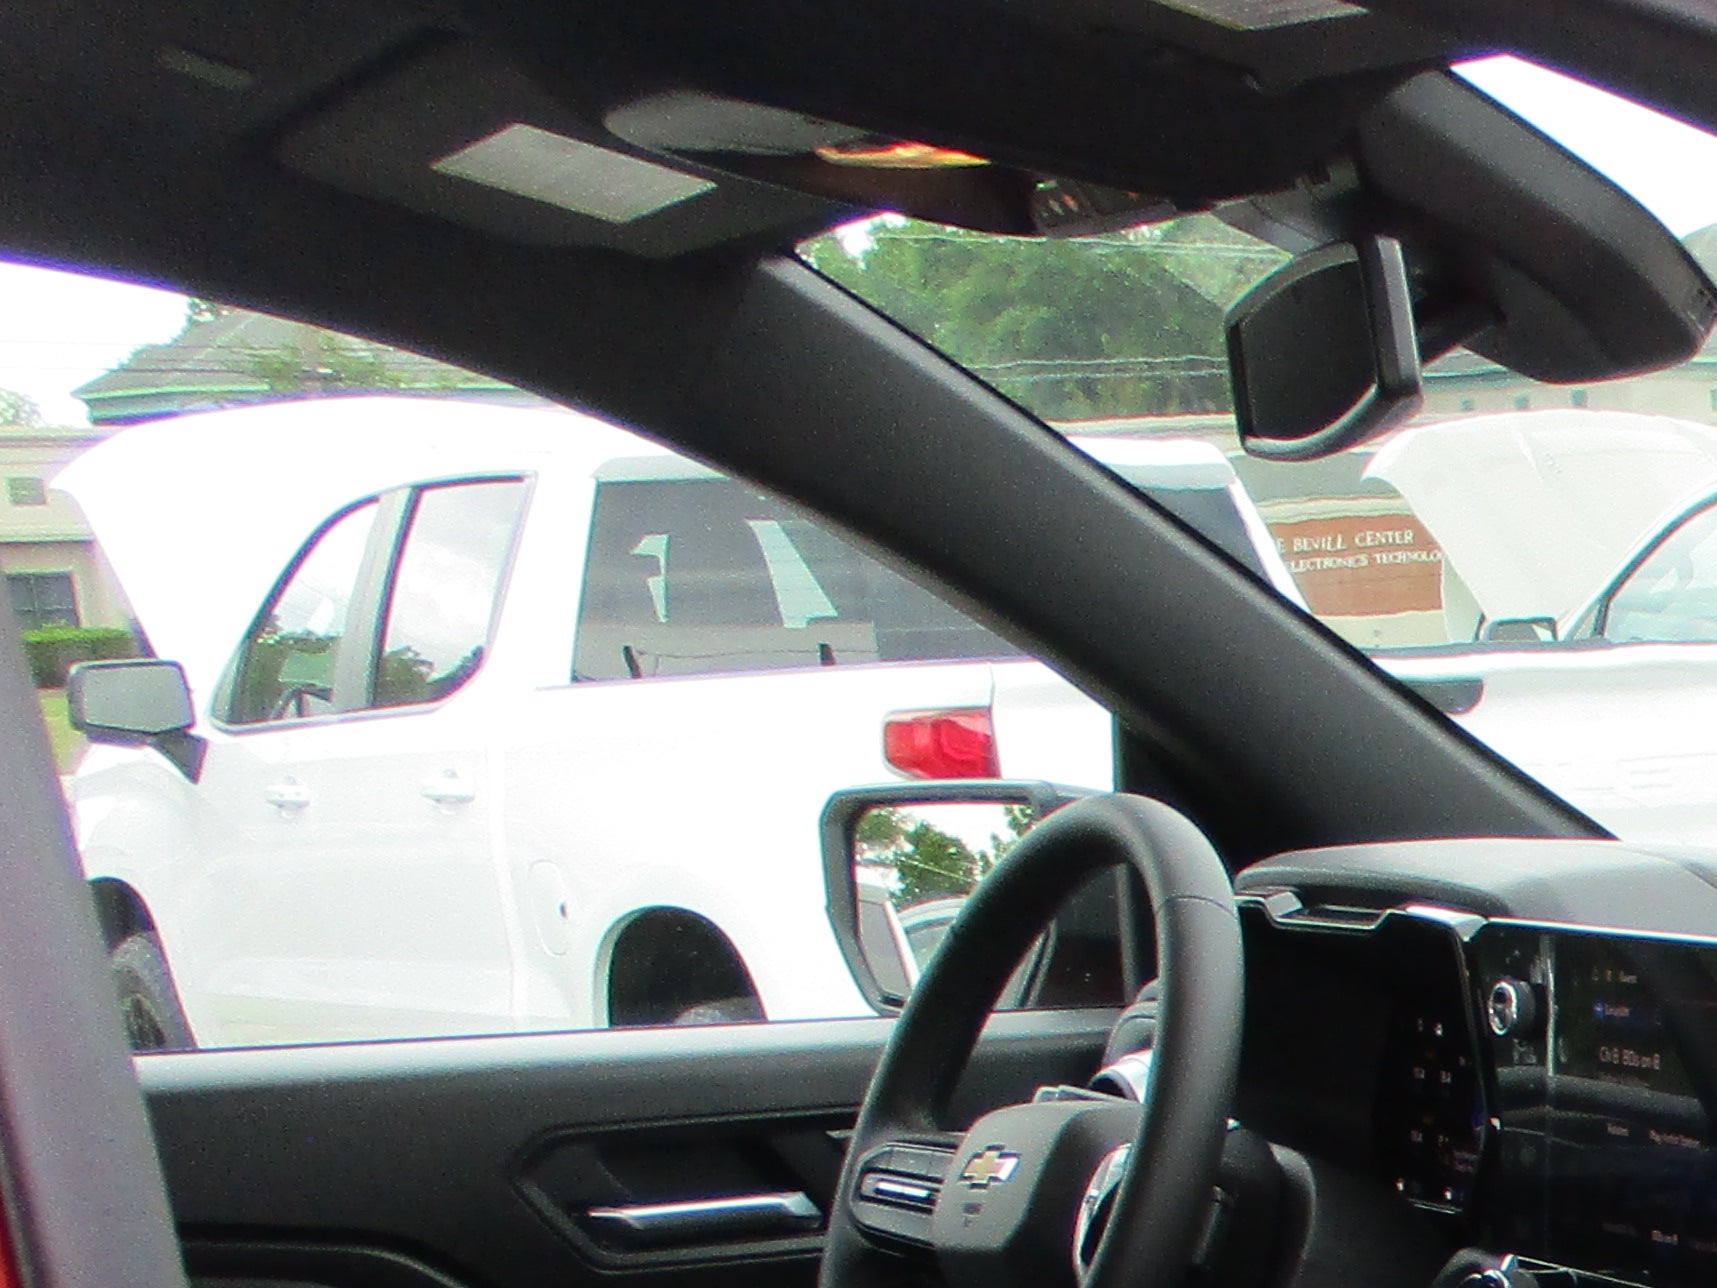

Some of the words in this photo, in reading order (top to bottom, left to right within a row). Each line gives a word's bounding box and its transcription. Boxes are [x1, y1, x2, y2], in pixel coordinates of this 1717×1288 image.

[1293, 533, 1347, 552] BEVILL
[1355, 529, 1414, 547] CENTER
[1375, 549, 1444, 565] TECHNOLO
